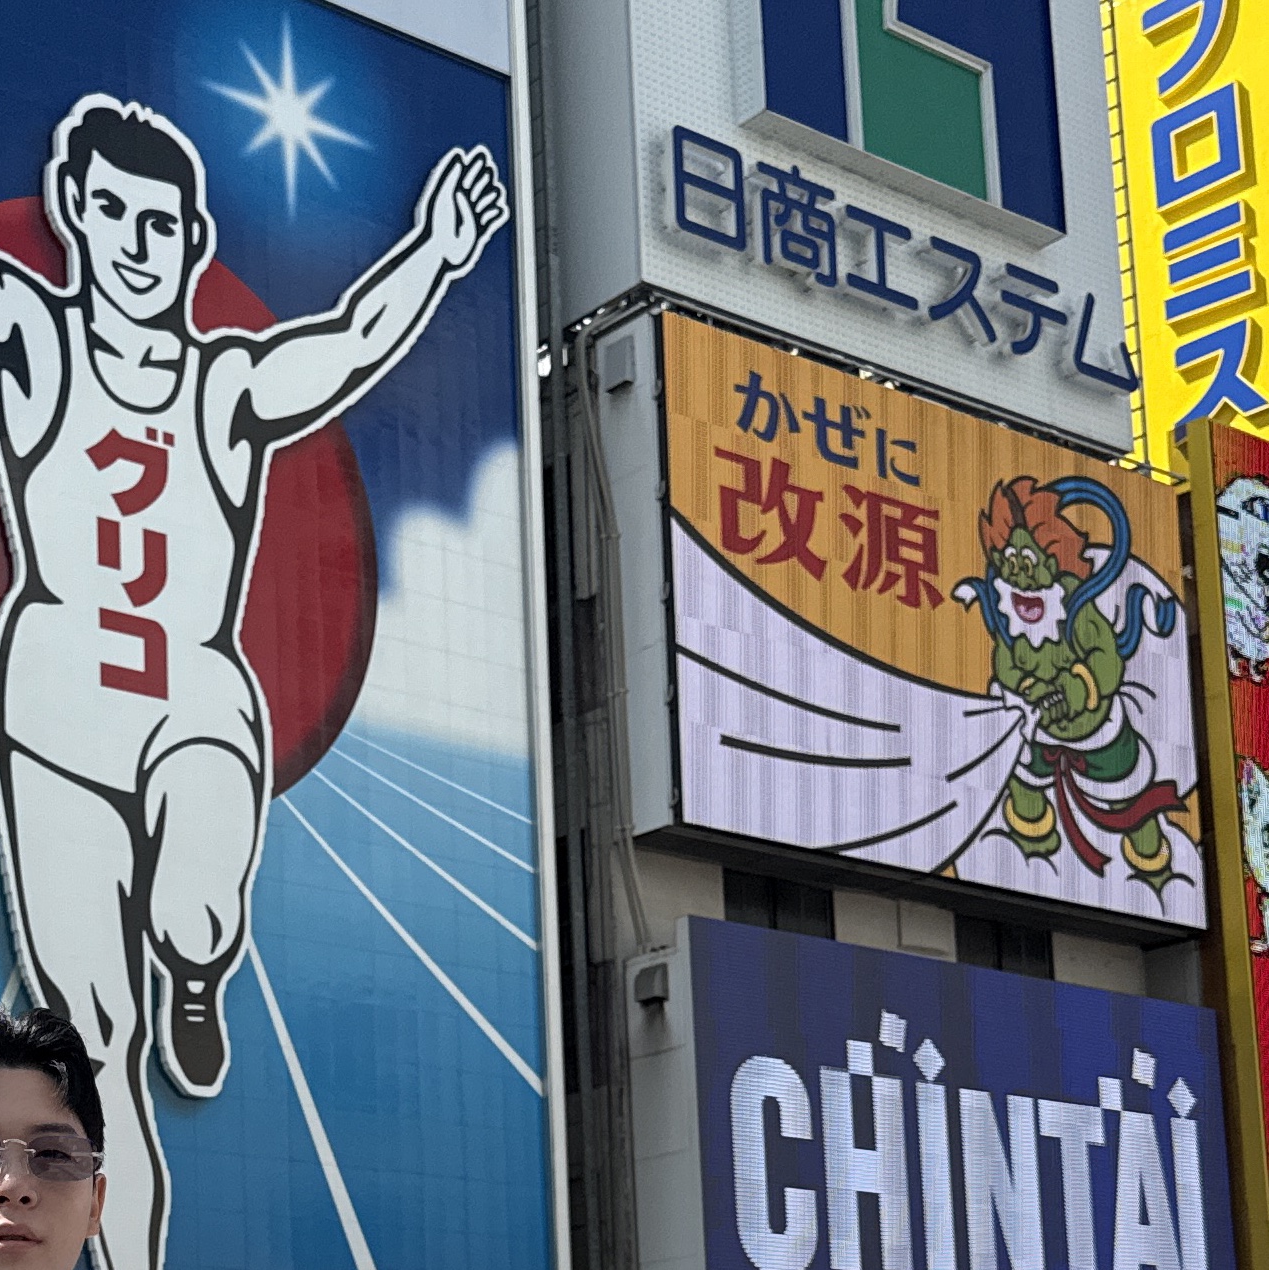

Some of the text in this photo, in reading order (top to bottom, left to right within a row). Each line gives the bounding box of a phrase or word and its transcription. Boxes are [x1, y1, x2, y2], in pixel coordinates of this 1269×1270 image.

[672, 124, 1139, 393] 日商エステム
[714, 445, 945, 610] 改源
[733, 370, 921, 487] かぜに
[84, 426, 176, 701] グリコ
